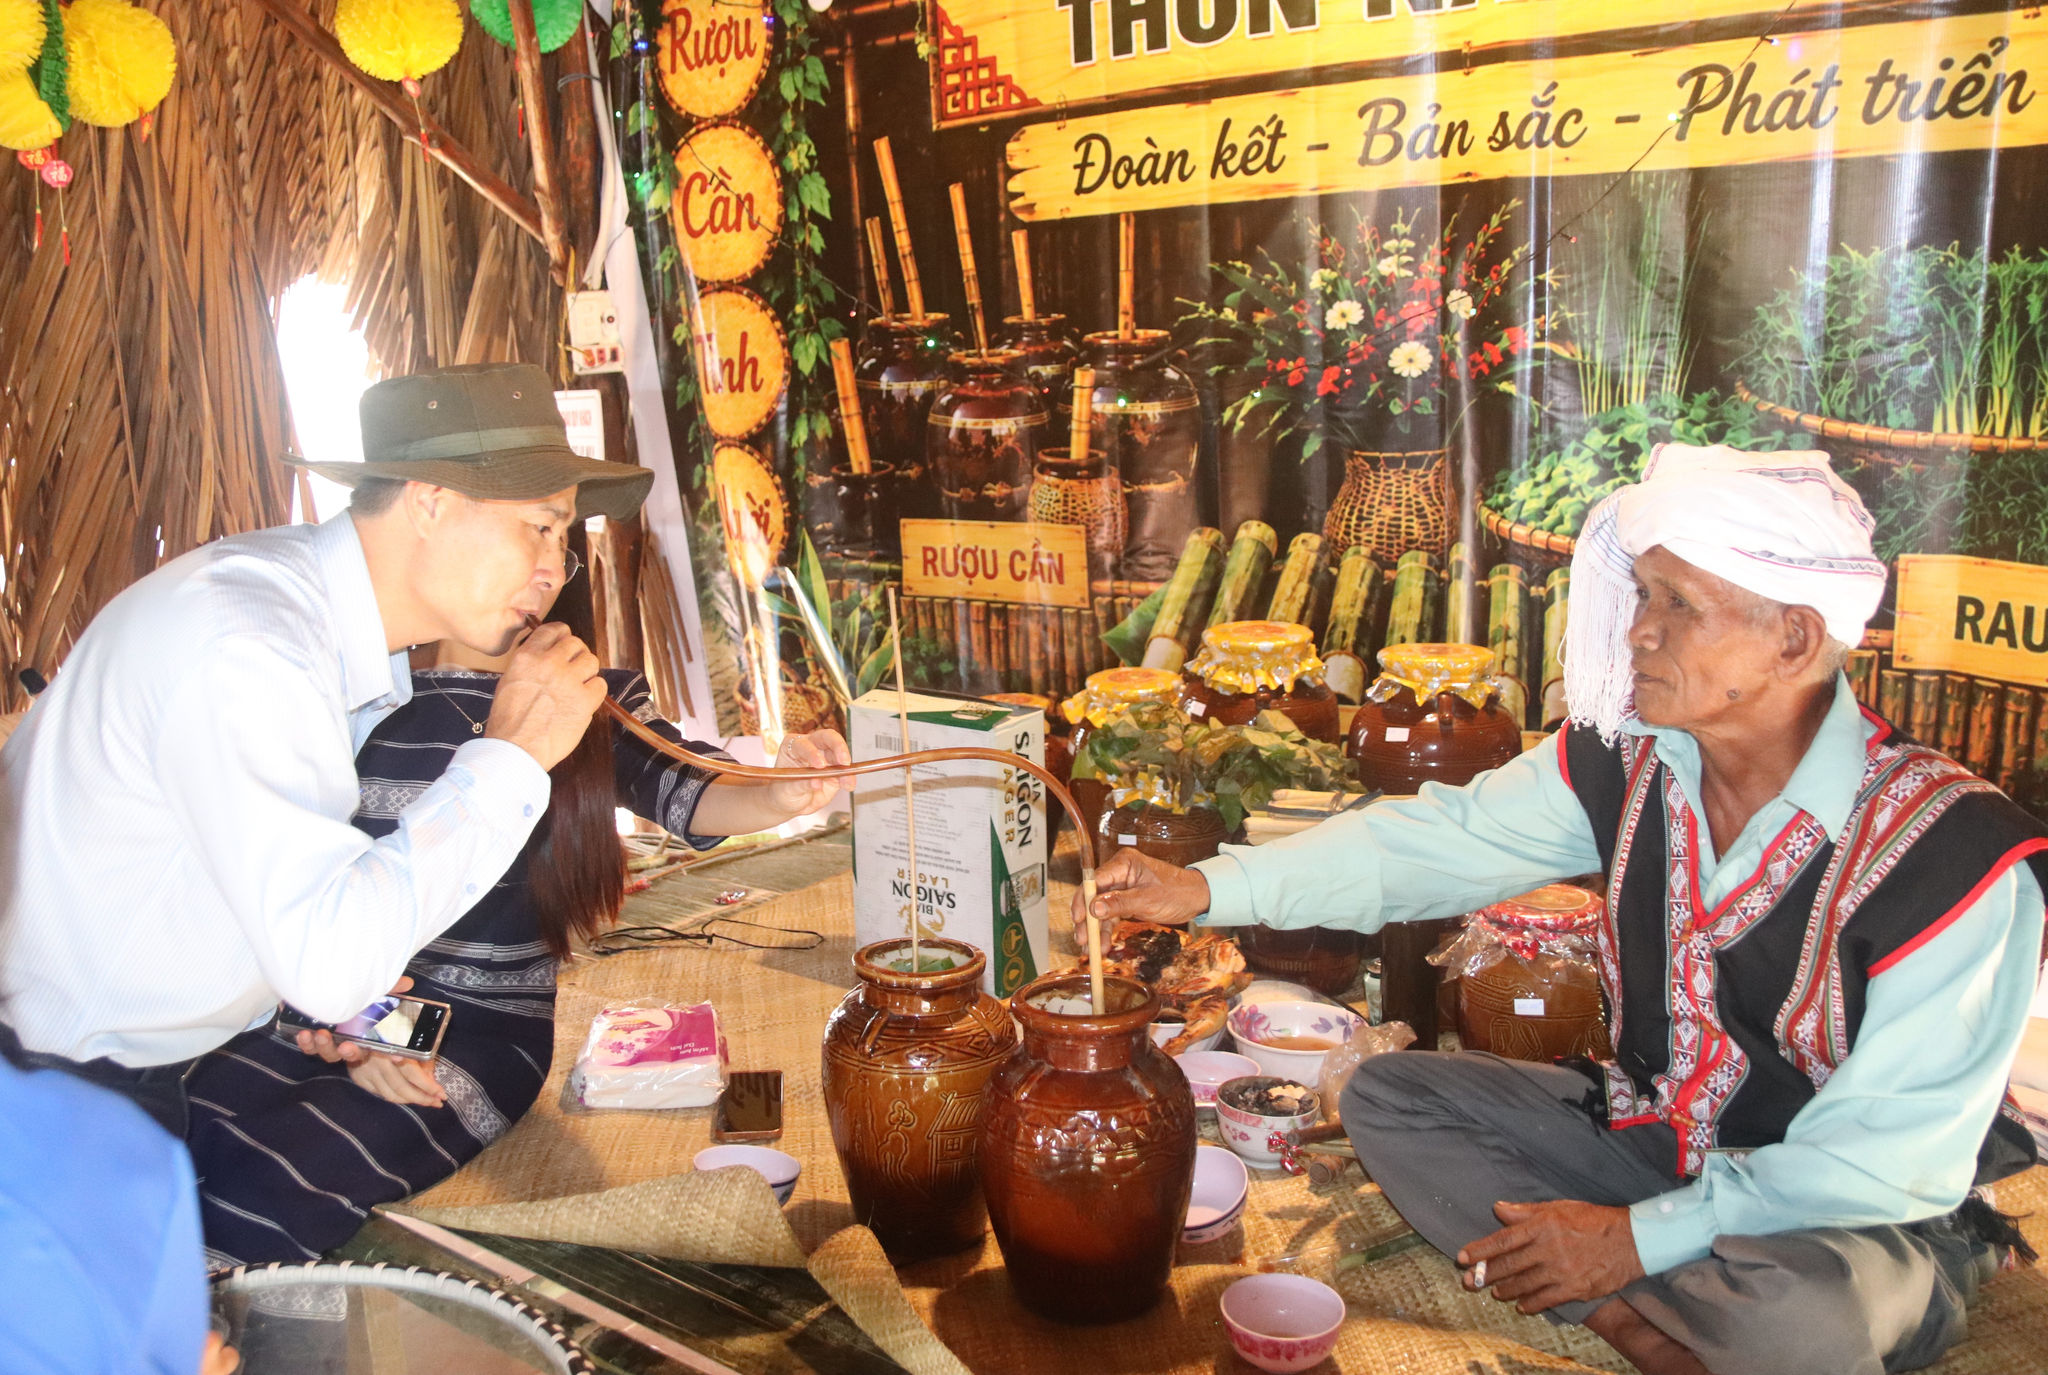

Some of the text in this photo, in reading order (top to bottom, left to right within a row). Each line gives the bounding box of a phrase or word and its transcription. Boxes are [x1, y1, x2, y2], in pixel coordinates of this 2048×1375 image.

[668, 7, 758, 78] Rượu
[1072, 132, 1195, 197] Đoàn
[1209, 113, 1287, 181] kết
[1357, 97, 1475, 168] Bản
[1487, 81, 1588, 153] sắc
[1675, 61, 1843, 142] Phát
[1861, 36, 2037, 127] triển
[50, 164, 68, 182] 福
[681, 165, 761, 240] Cần
[921, 536, 1066, 586] RƯỢU CẦN
[1953, 594, 2048, 654] RAU
[1003, 748, 1016, 845] AGER
